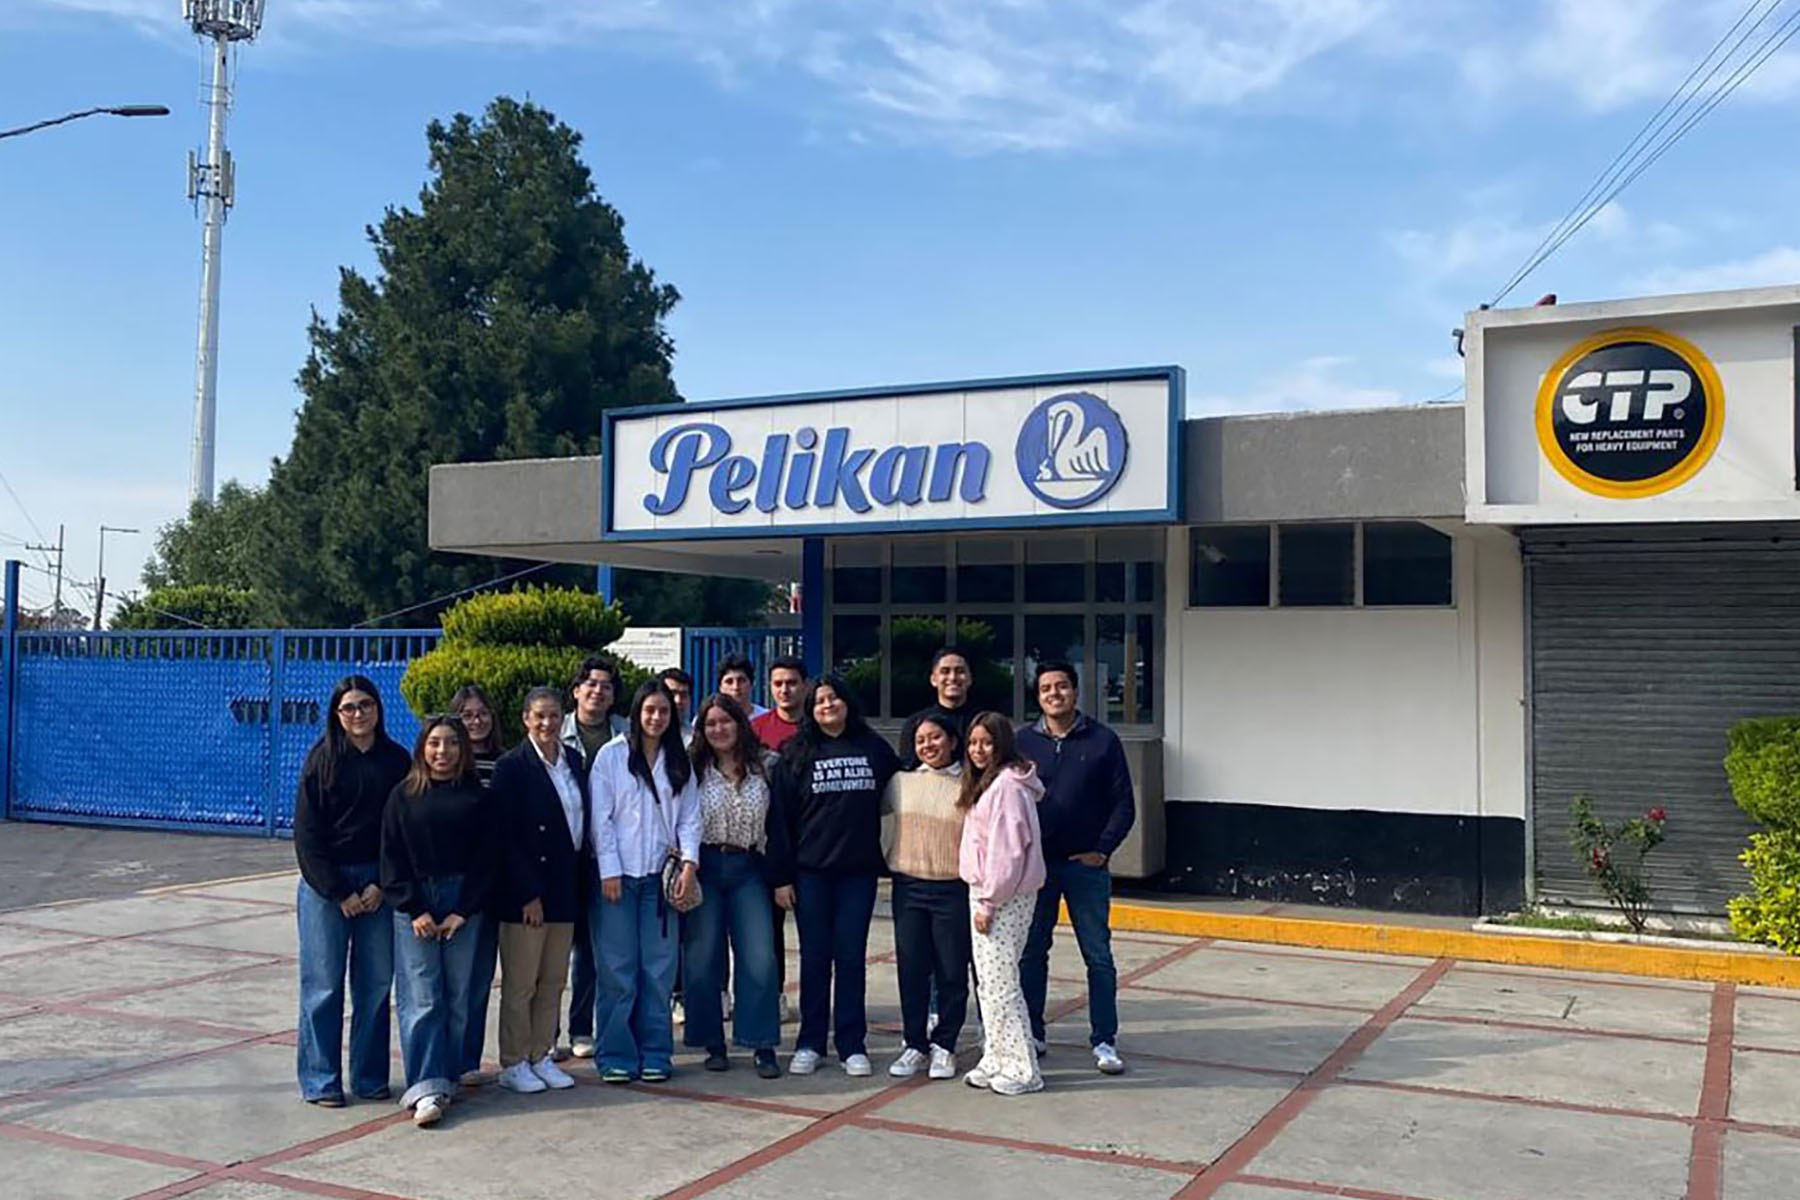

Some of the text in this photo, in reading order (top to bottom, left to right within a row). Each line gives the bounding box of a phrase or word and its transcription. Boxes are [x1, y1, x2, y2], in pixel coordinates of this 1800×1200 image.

[1569, 428, 1685, 441] NEW REPLACEMENT PARTS
[1576, 440, 1678, 453] FOR HEAVY EQUIPMENT
[643, 422, 991, 516] Pelikan
[815, 756, 868, 769] EVERYONE
[813, 767, 873, 781] IS AN ALIEN
[811, 779, 875, 793] SOMEWHERE
